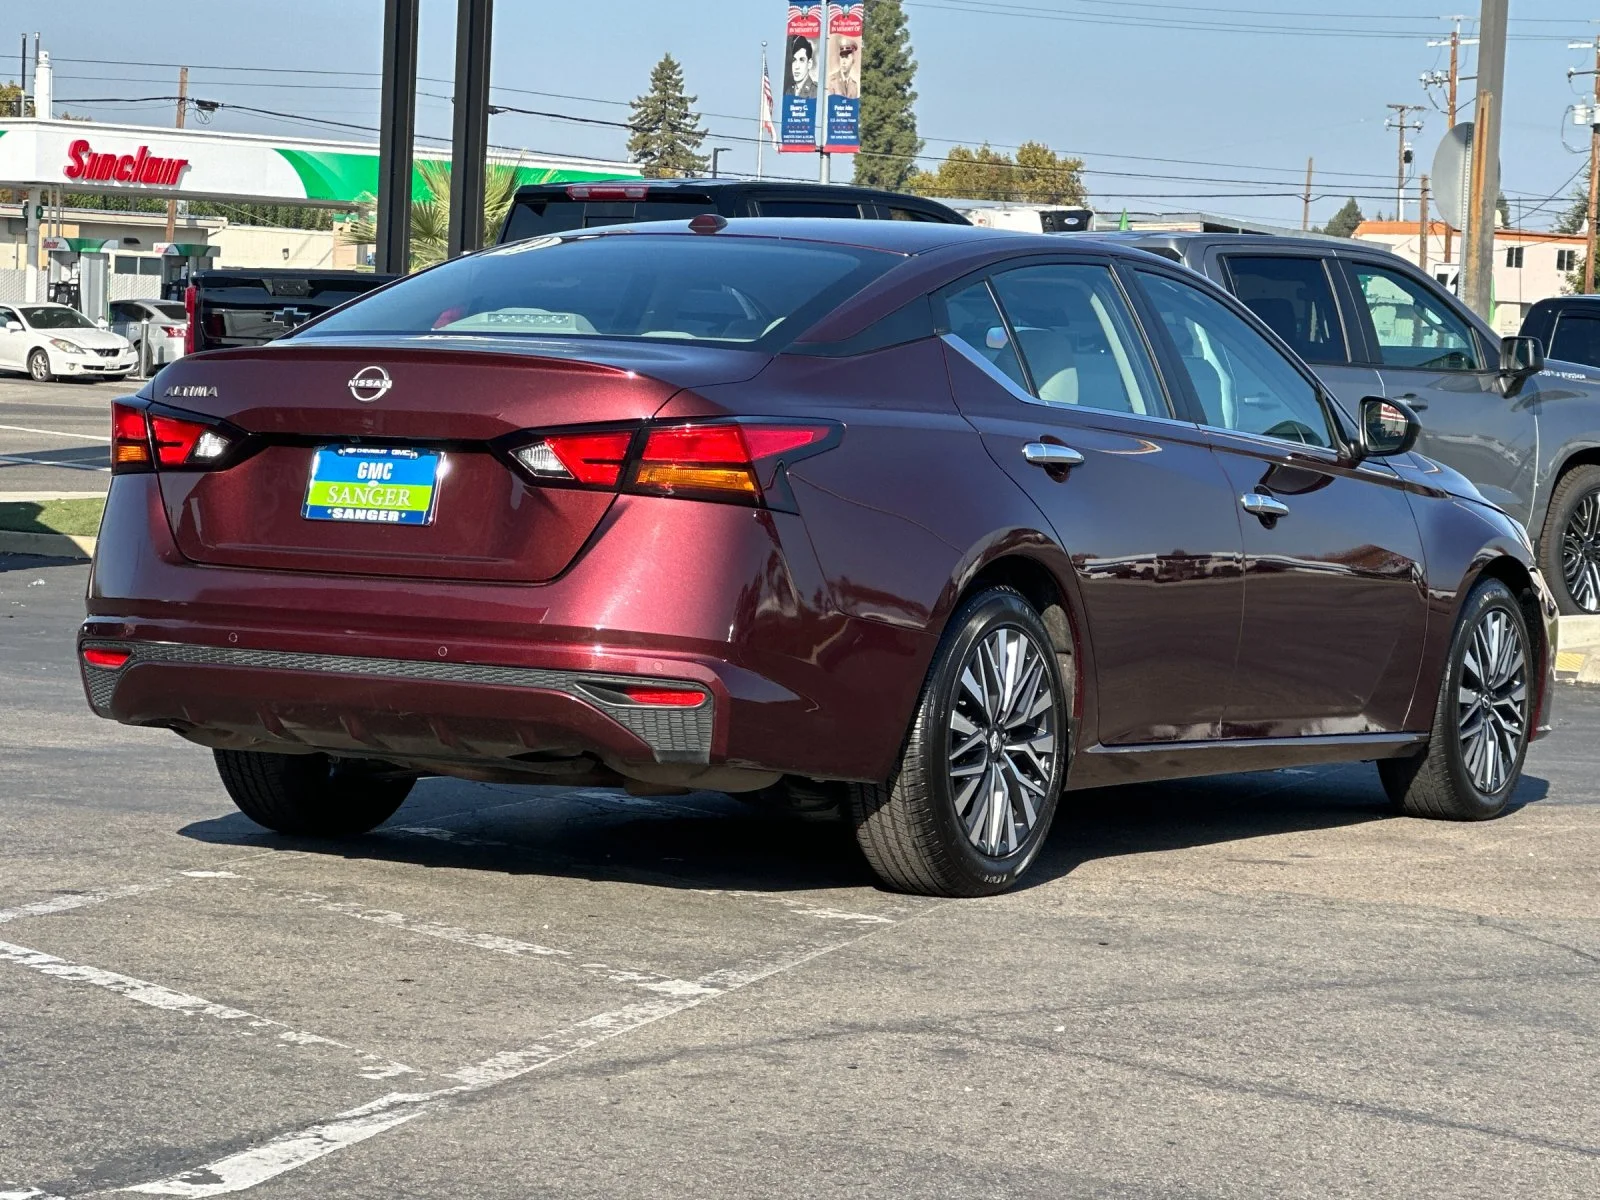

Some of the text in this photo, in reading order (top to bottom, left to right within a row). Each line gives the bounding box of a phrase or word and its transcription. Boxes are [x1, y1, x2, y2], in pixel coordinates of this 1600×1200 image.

[63, 139, 190, 186] Sinclair
[164, 385, 218, 398] ALTIMA
[348, 379, 393, 389] NISSAN
[357, 461, 394, 480] GMC
[326, 485, 413, 507] SANGER
[332, 507, 400, 521] SANGER
